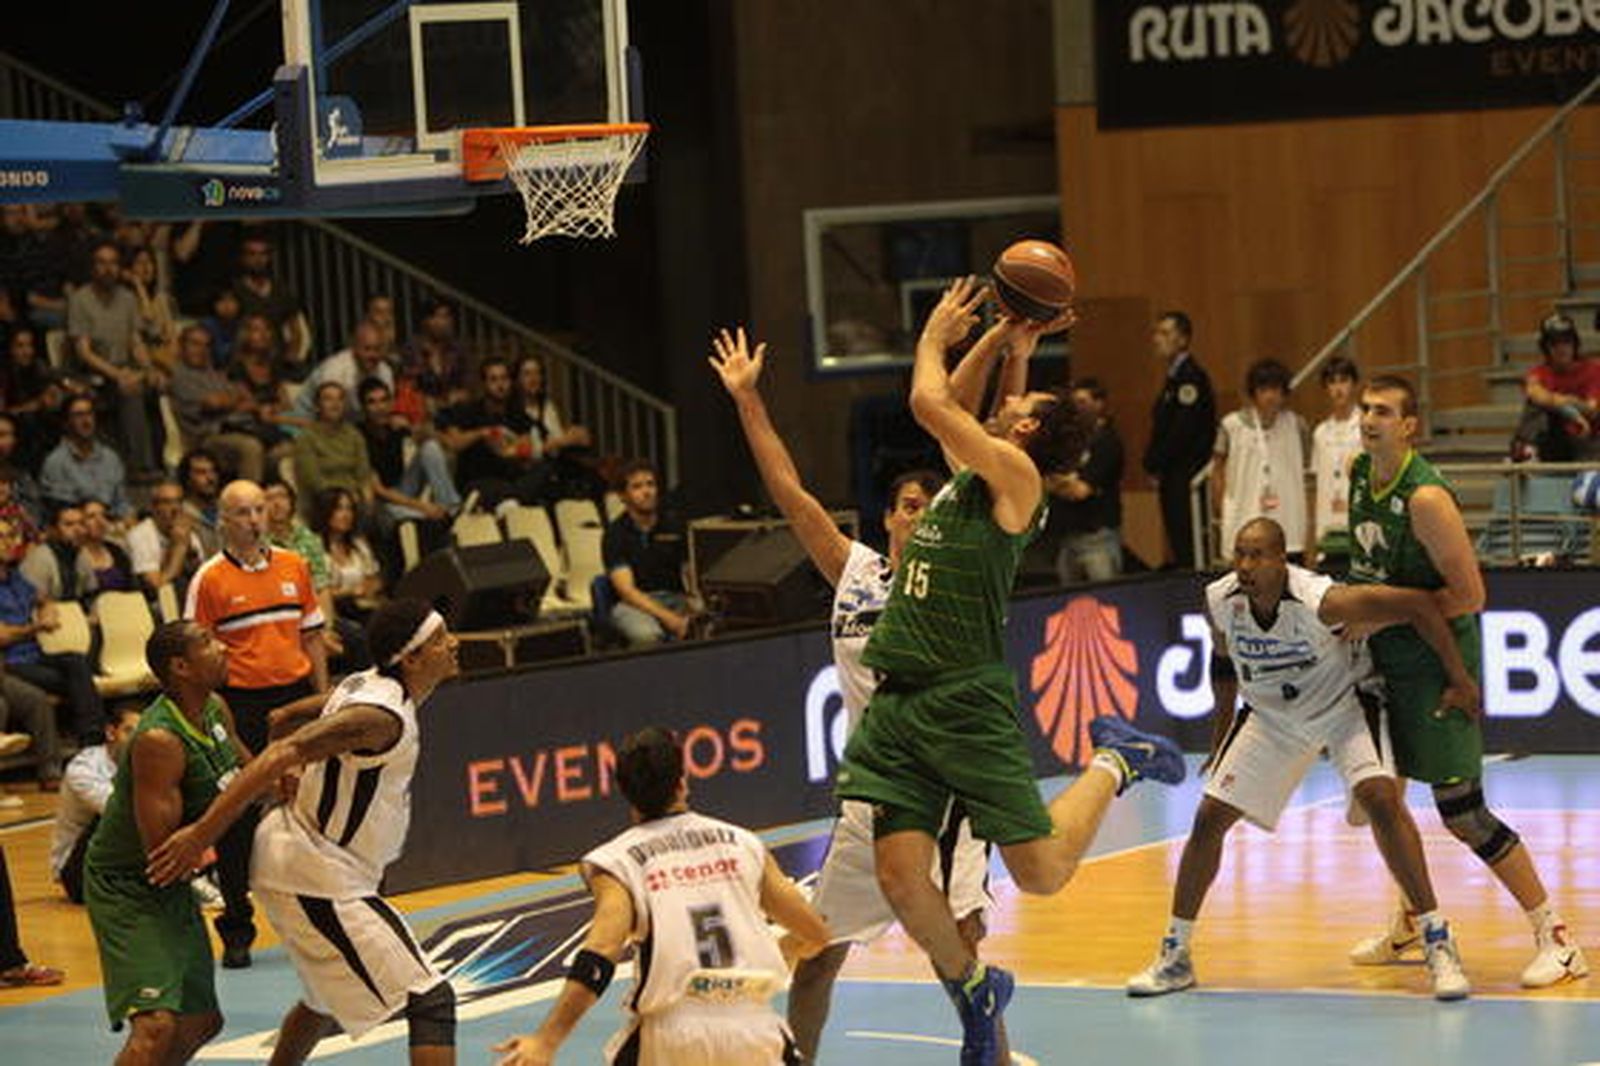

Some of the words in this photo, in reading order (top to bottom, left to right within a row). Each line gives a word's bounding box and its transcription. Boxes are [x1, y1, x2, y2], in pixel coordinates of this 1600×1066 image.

[1129, 4, 1271, 62] RUTA
[904, 559, 931, 600] 15
[467, 719, 766, 818] EVEOS
[687, 903, 735, 969] 5
